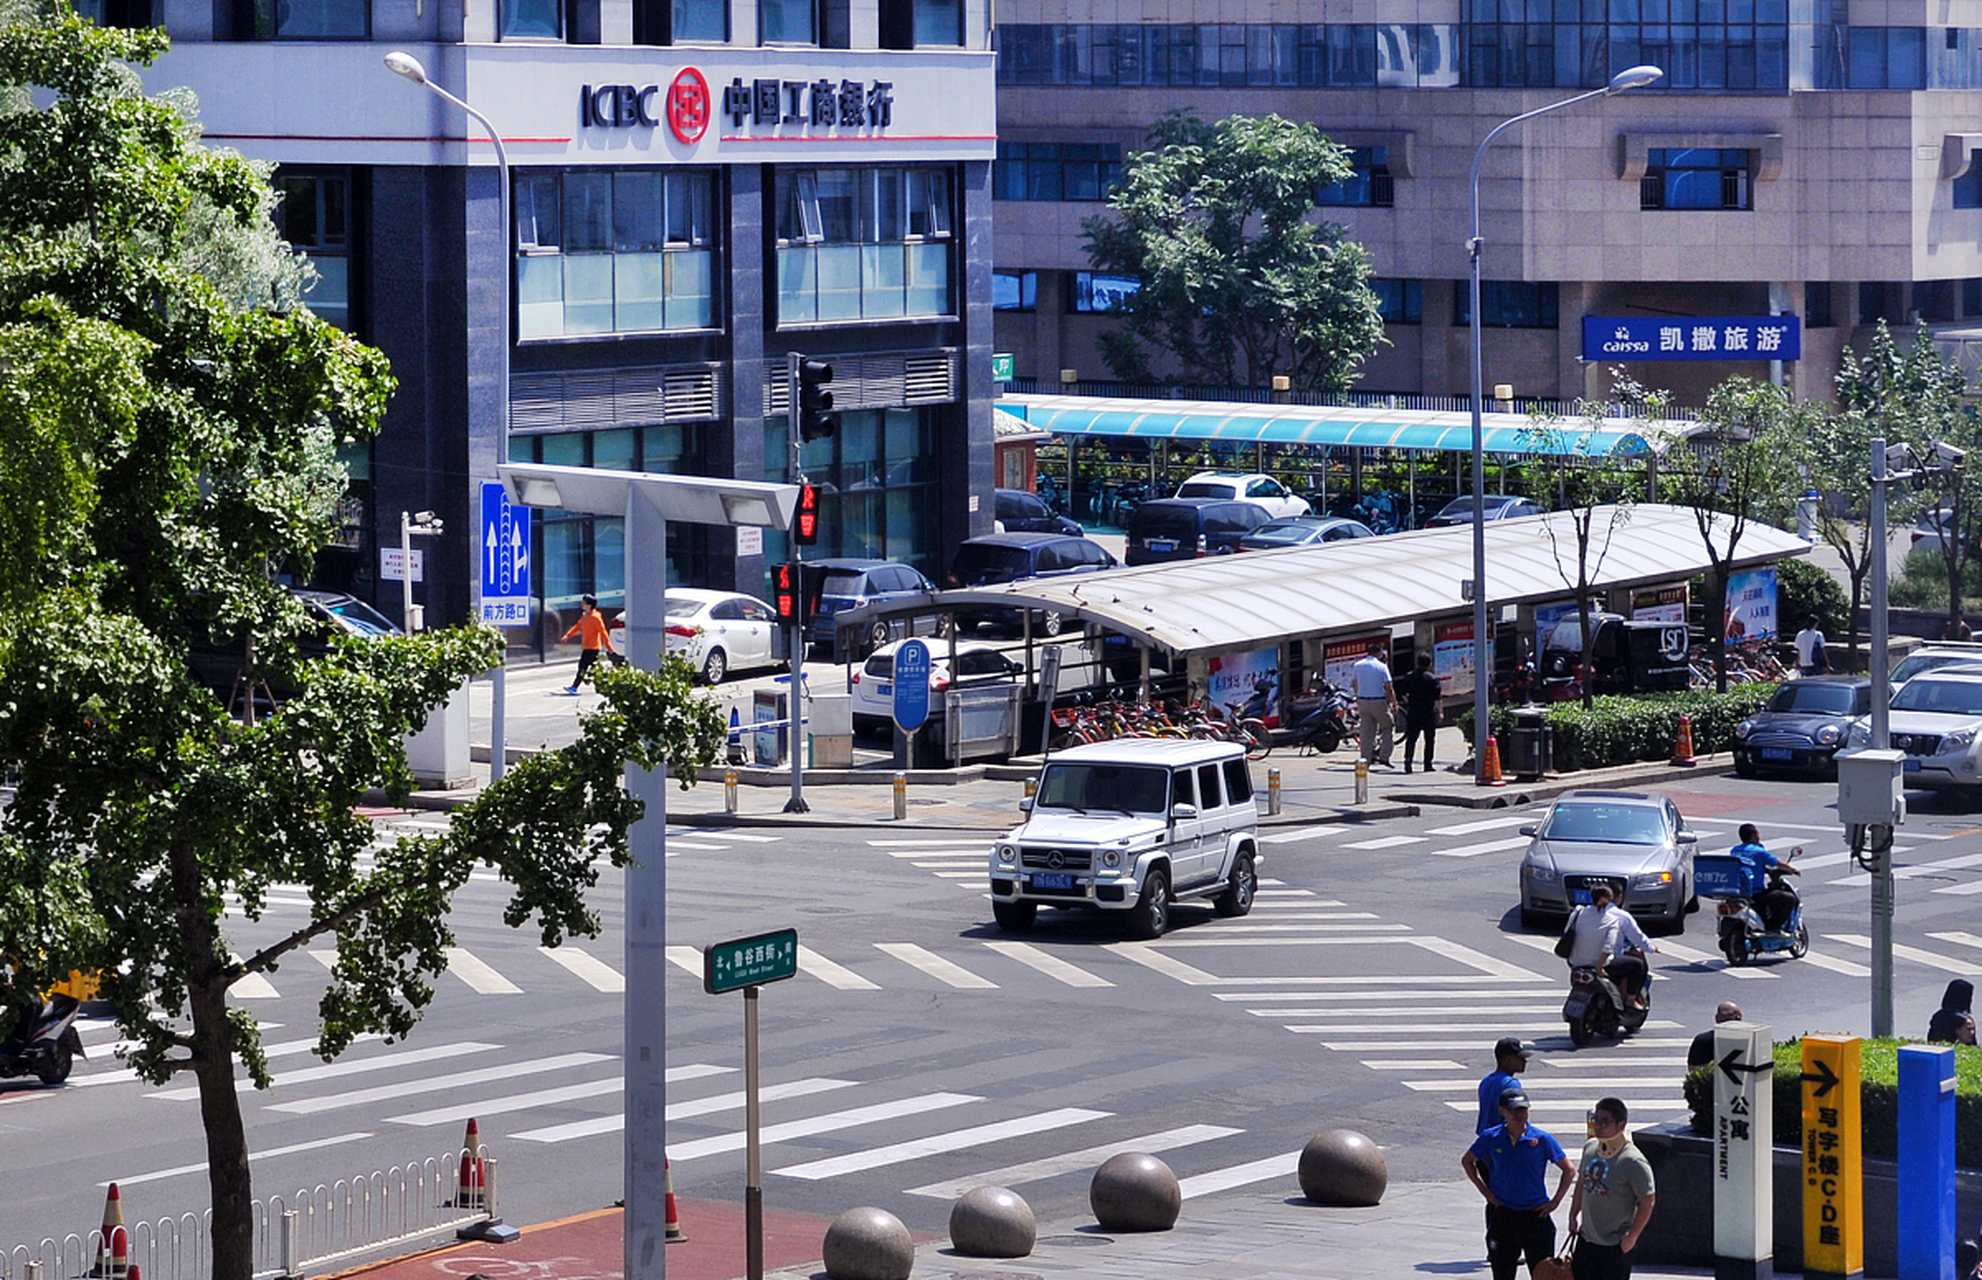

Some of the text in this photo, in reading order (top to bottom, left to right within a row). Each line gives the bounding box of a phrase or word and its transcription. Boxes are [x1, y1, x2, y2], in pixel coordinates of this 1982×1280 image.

[581, 84, 659, 128] ICBC
[724, 77, 894, 128] 中国工商银行
[1603, 341, 1649, 353] caissa
[1660, 326, 1782, 352] 凯撒旅游
[483, 603, 526, 620] 前方路口
[734, 943, 775, 967] 鲁谷西街
[1730, 1095, 1750, 1141] 公寓
[1718, 1115, 1729, 1180] APARTMENT
[1808, 1128, 1817, 1164] TOWER
